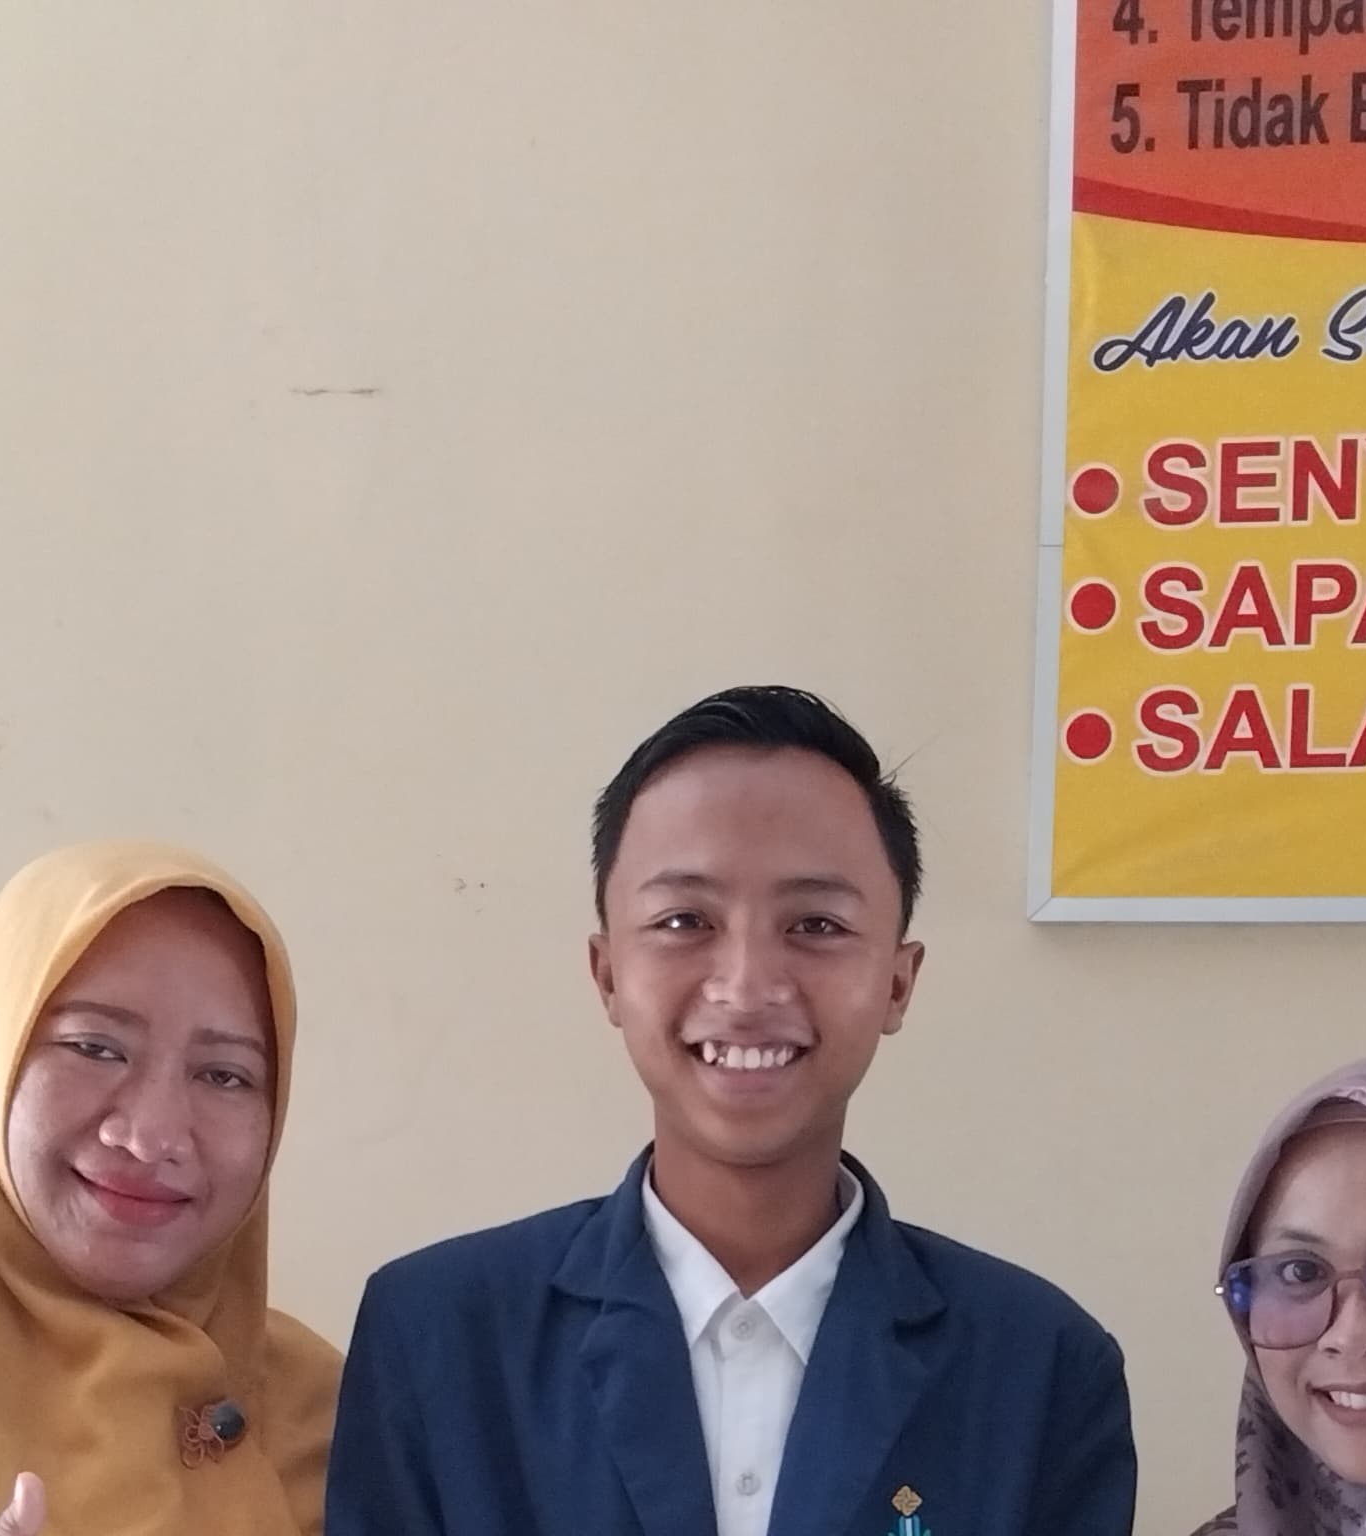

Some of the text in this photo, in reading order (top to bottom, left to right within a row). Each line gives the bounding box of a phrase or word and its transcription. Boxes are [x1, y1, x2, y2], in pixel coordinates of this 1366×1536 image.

[1111, 0, 1159, 45] 4.
[1109, 82, 1157, 154] 5.
[1176, 74, 1331, 150] Tidak
[1093, 291, 1300, 372] Akan
